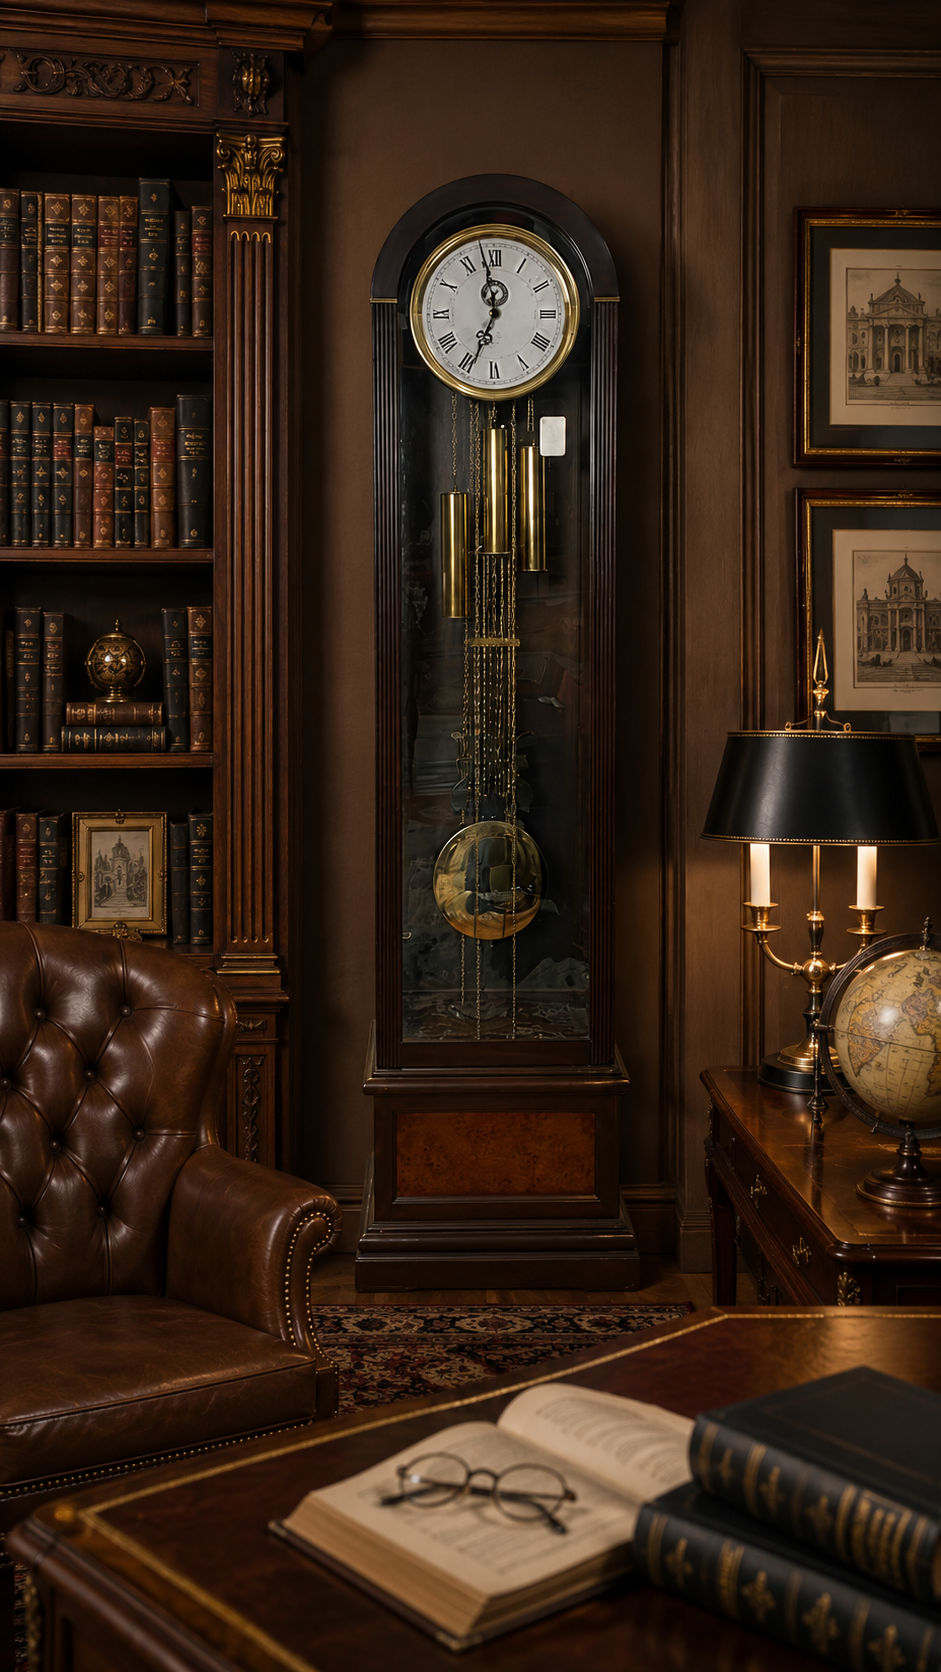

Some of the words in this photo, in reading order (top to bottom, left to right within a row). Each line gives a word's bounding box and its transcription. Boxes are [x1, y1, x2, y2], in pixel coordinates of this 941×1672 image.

[459, 256, 477, 276] XI
[488, 250, 502, 267] XII
[516, 258, 527, 274] I
[440, 279, 458, 293] X
[533, 280, 550, 293] II
[433, 309, 449, 319] IX
[540, 309, 556, 319] III
[438, 331, 458, 354] VIII
[531, 332, 551, 352] IIII
[458, 352, 476, 374] VII
[489, 361, 500, 379] VI
[516, 354, 530, 371] V
